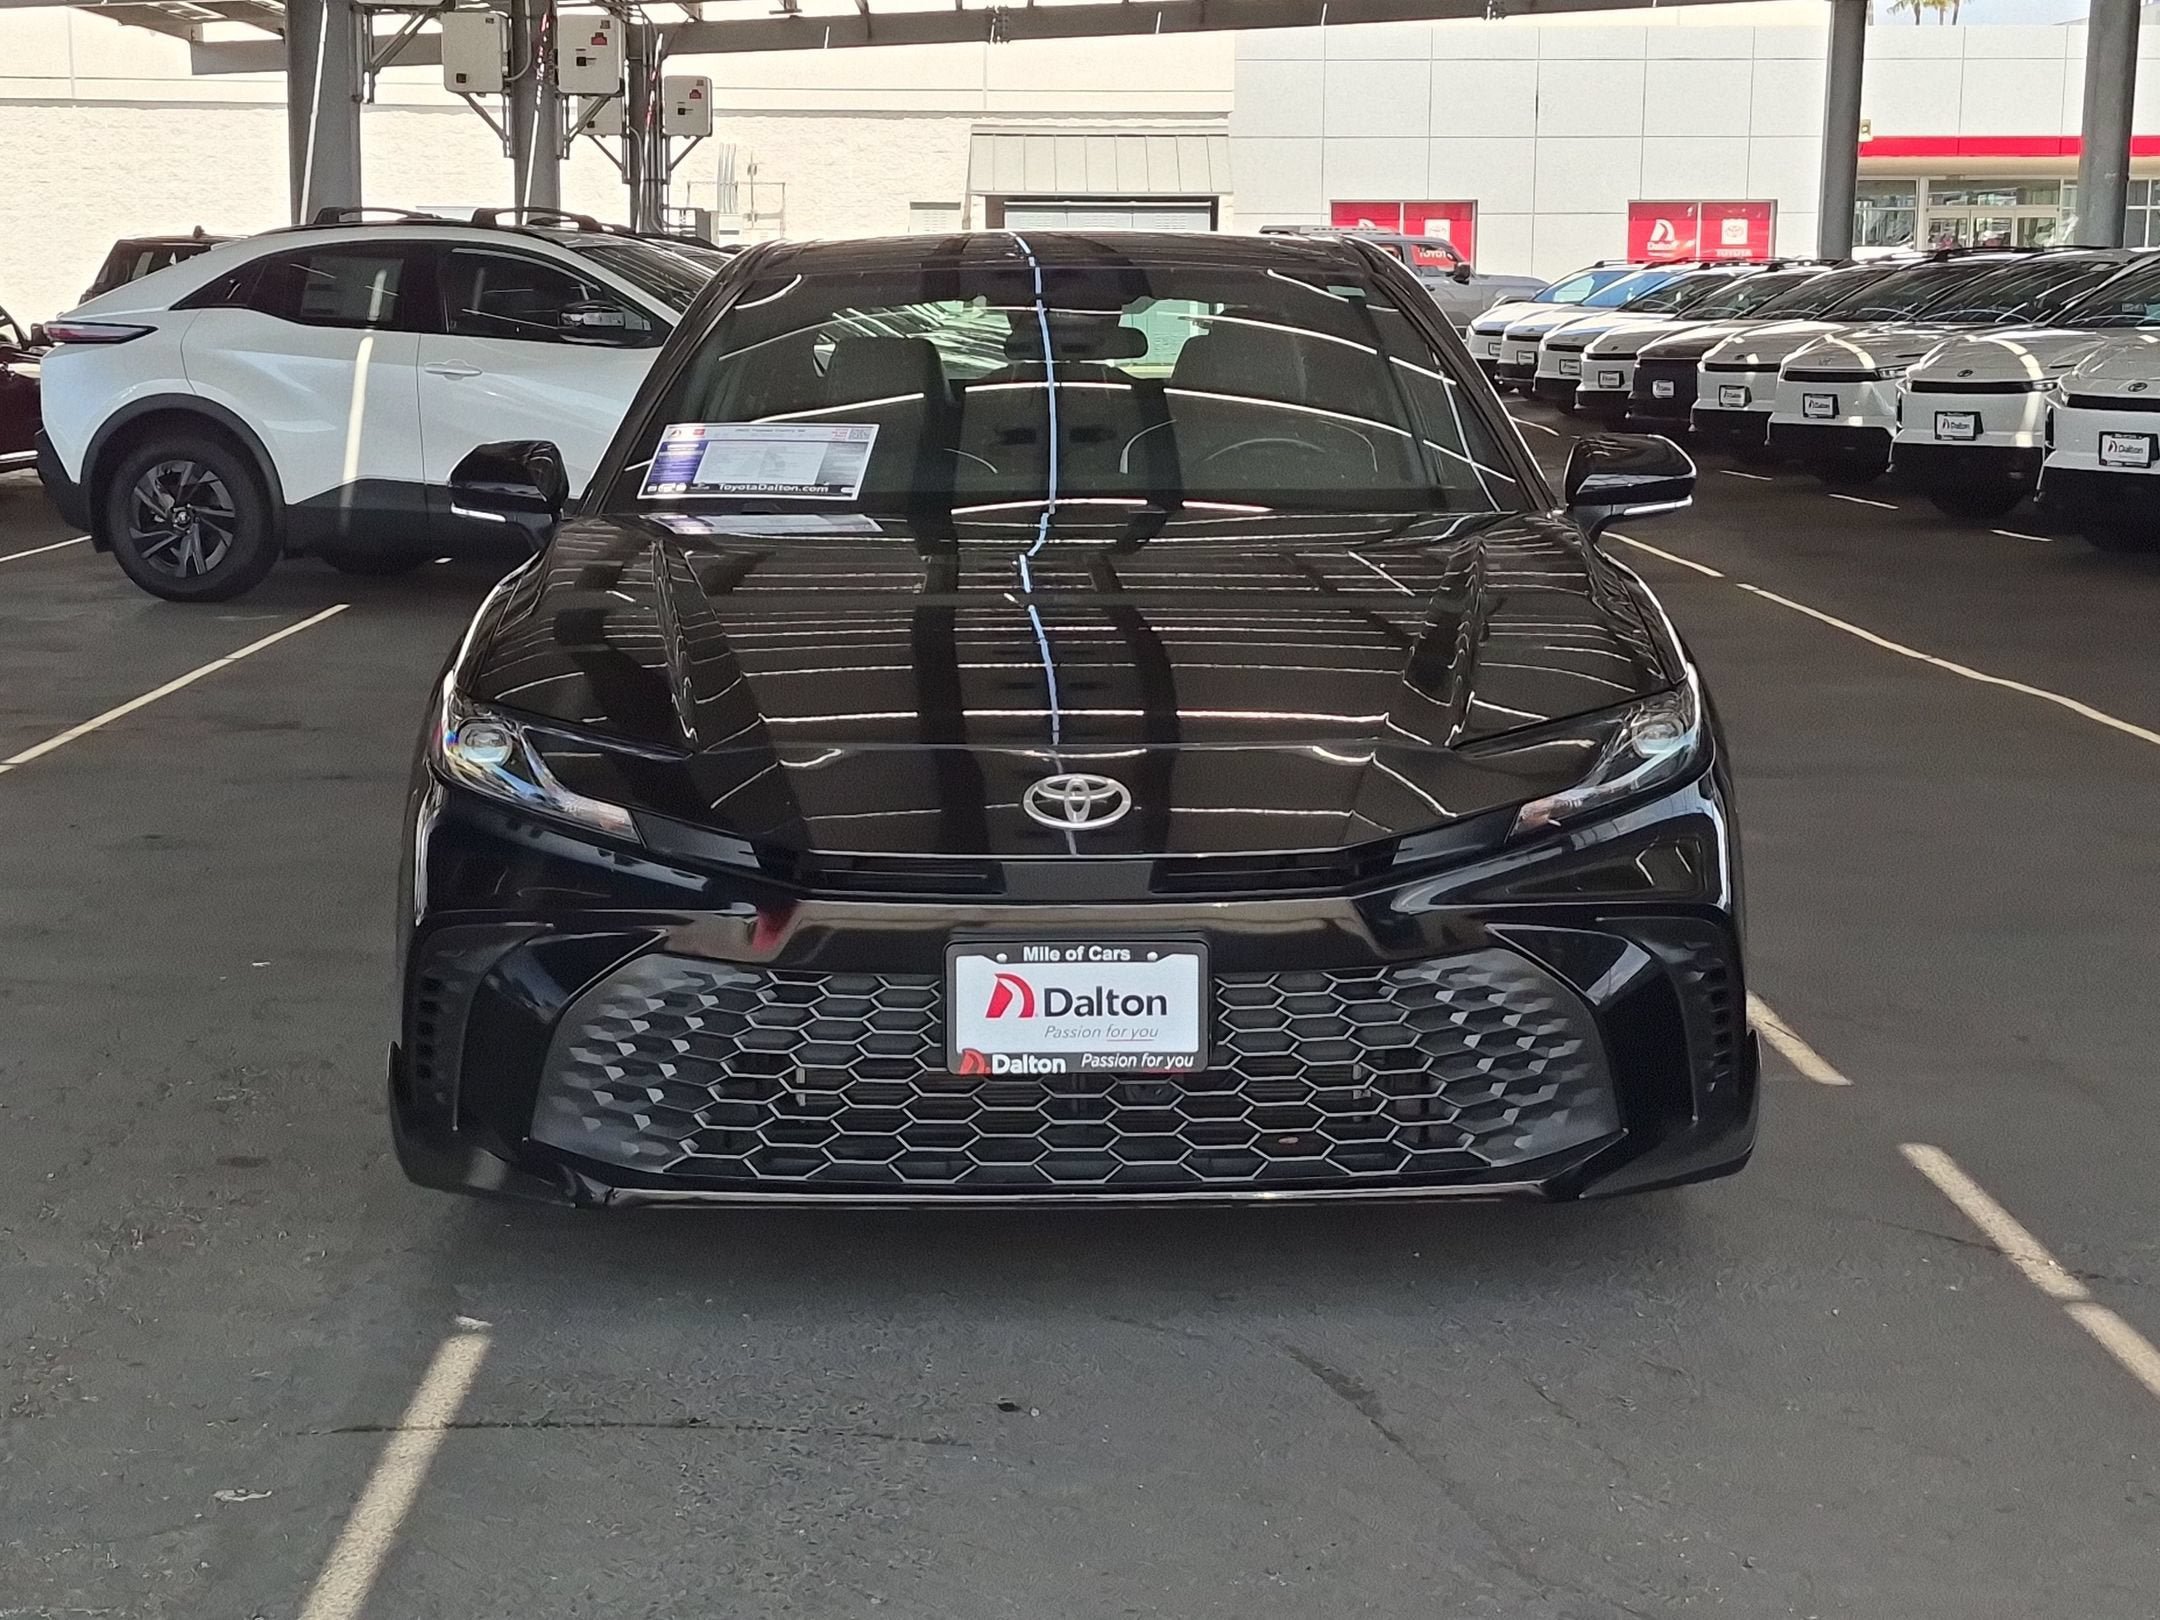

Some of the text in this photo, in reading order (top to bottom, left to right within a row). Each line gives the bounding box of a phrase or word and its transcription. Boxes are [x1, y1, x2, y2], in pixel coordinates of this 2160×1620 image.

[2119, 444, 2144, 454] Dalton
[720, 483, 829, 494] ToyotaDalton.com
[1023, 945, 1131, 961] Mile of Cars
[1043, 986, 1167, 1017] Dalton
[1044, 1023, 1159, 1040] Passion for you
[991, 1053, 1067, 1074] Dalton
[1081, 1052, 1194, 1070] Passion for you
